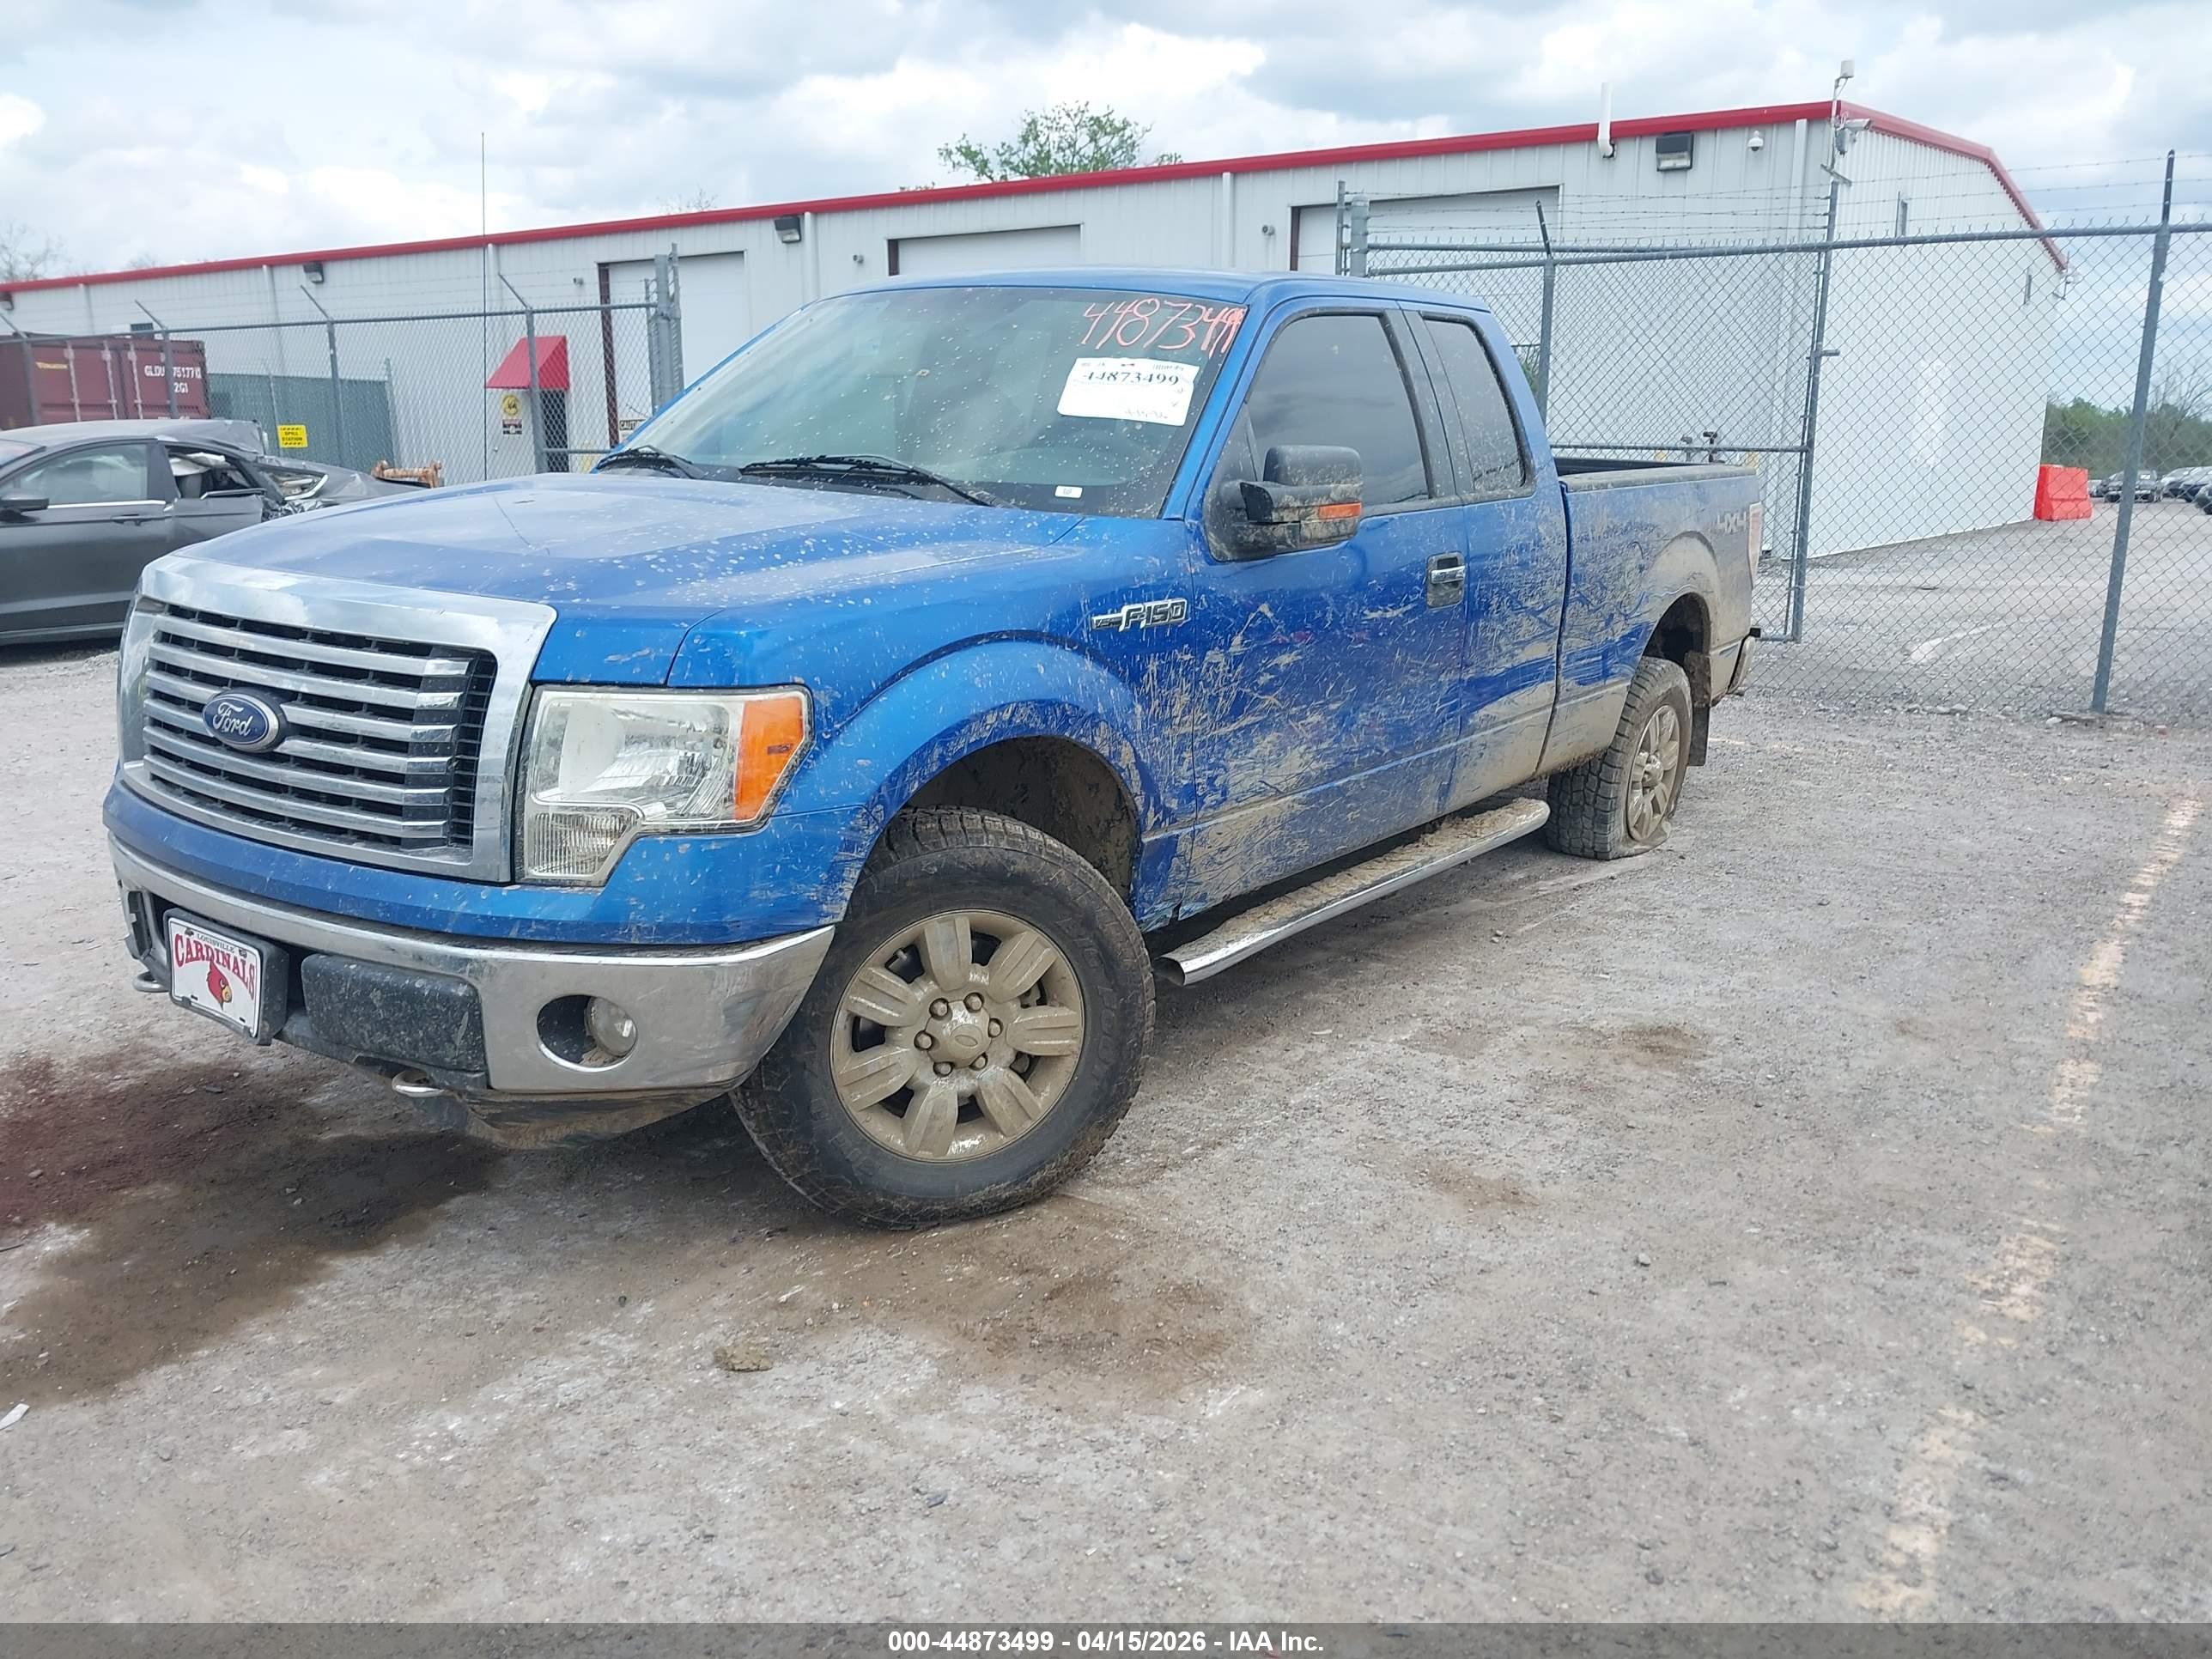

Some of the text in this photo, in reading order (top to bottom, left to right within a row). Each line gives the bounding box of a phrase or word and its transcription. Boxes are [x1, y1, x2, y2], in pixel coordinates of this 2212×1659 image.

[1082, 370, 1180, 386] 44873499
[212, 702, 253, 737] Ford
[196, 933, 235, 954] LOUISVILLE
[174, 933, 256, 1001] CARDINALS
